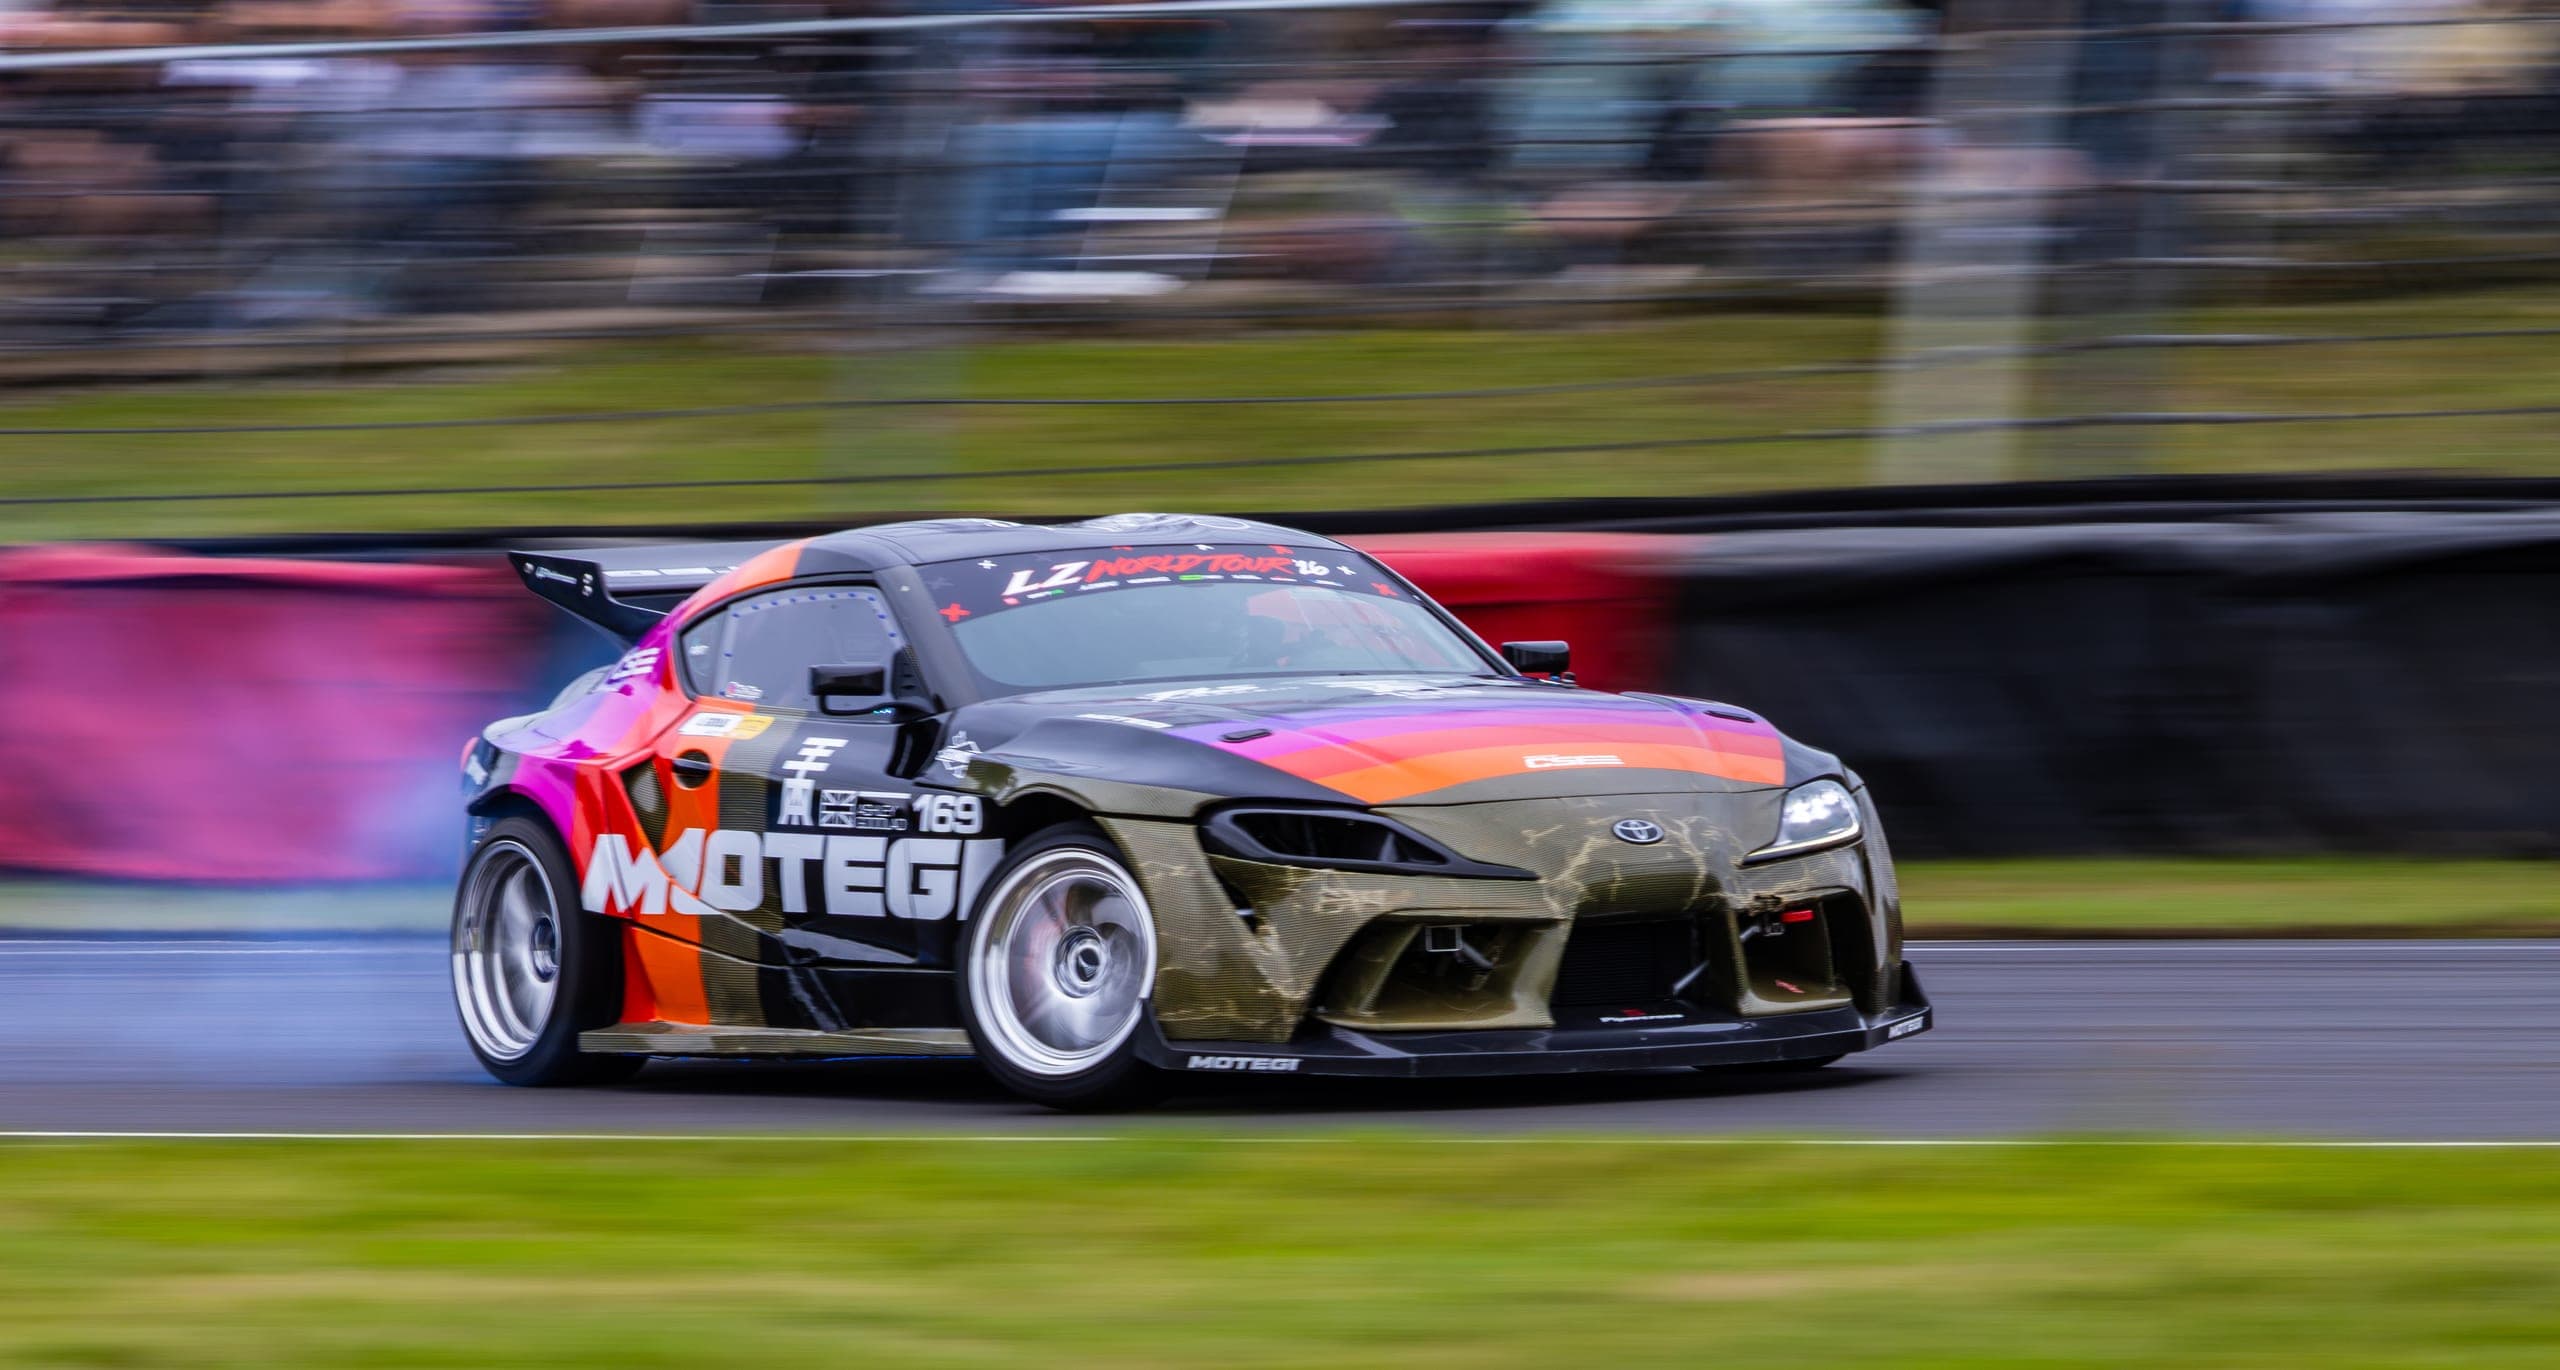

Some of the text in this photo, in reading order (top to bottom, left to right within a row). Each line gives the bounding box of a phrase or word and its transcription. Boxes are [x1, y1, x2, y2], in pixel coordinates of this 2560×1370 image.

[1001, 561, 1090, 596] LZ
[1084, 554, 1200, 583] WORLD
[1198, 554, 1295, 575] TOUR
[912, 794, 984, 834] 169
[581, 828, 1006, 921] MOTEGI
[1187, 1056, 1304, 1071] MOTEGI
